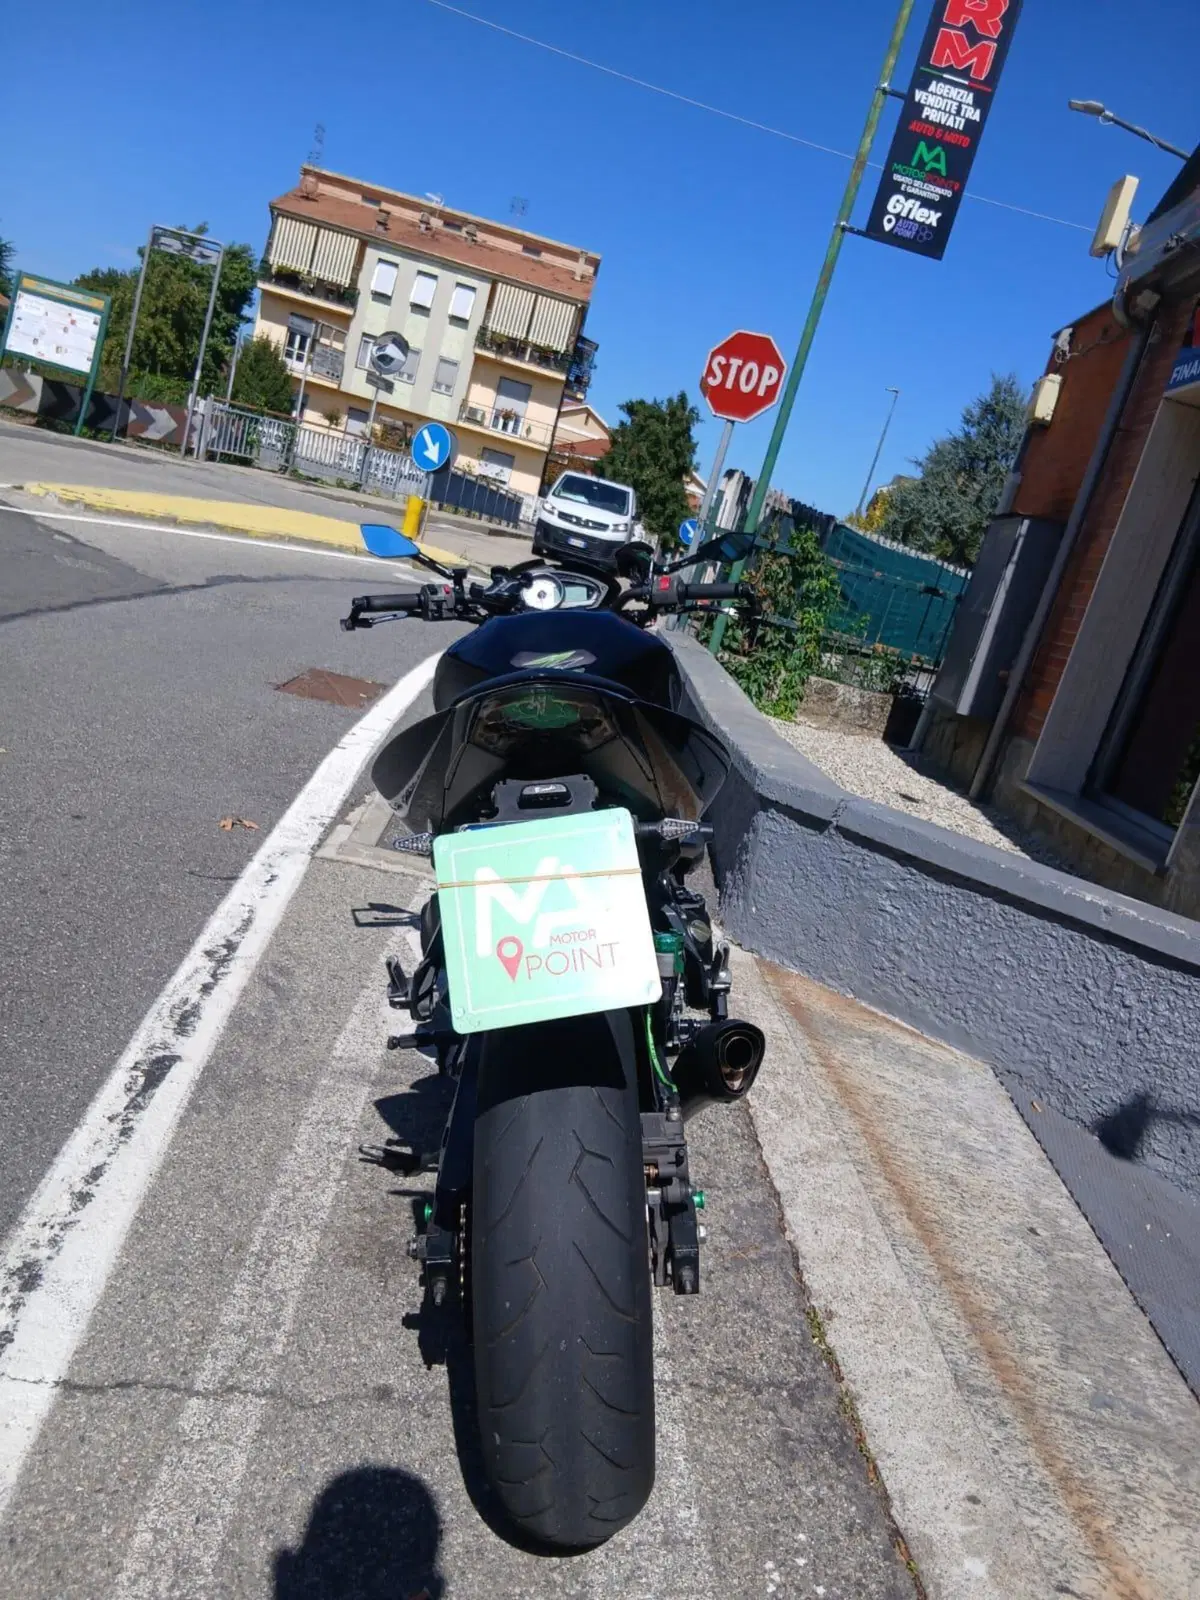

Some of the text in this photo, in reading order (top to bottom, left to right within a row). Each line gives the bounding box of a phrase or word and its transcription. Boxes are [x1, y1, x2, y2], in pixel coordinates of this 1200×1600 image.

[928, 80, 974, 105] AGENZIA
[914, 89, 981, 122] VENDITE TRA
[921, 107, 966, 131] PRIVATI
[908, 120, 935, 137] AUTO
[943, 131, 970, 148] MOTO
[893, 173, 953, 198] USATO SELEZIONATO
[907, 185, 940, 201] GARANTITO
[886, 194, 942, 227] Gflex
[893, 227, 917, 240] POINT
[896, 218, 919, 232] AUTO
[707, 355, 779, 397] STOP
[1169, 360, 1200, 385] FINA
[550, 928, 597, 946] MOTOR
[525, 941, 620, 980] POINT
